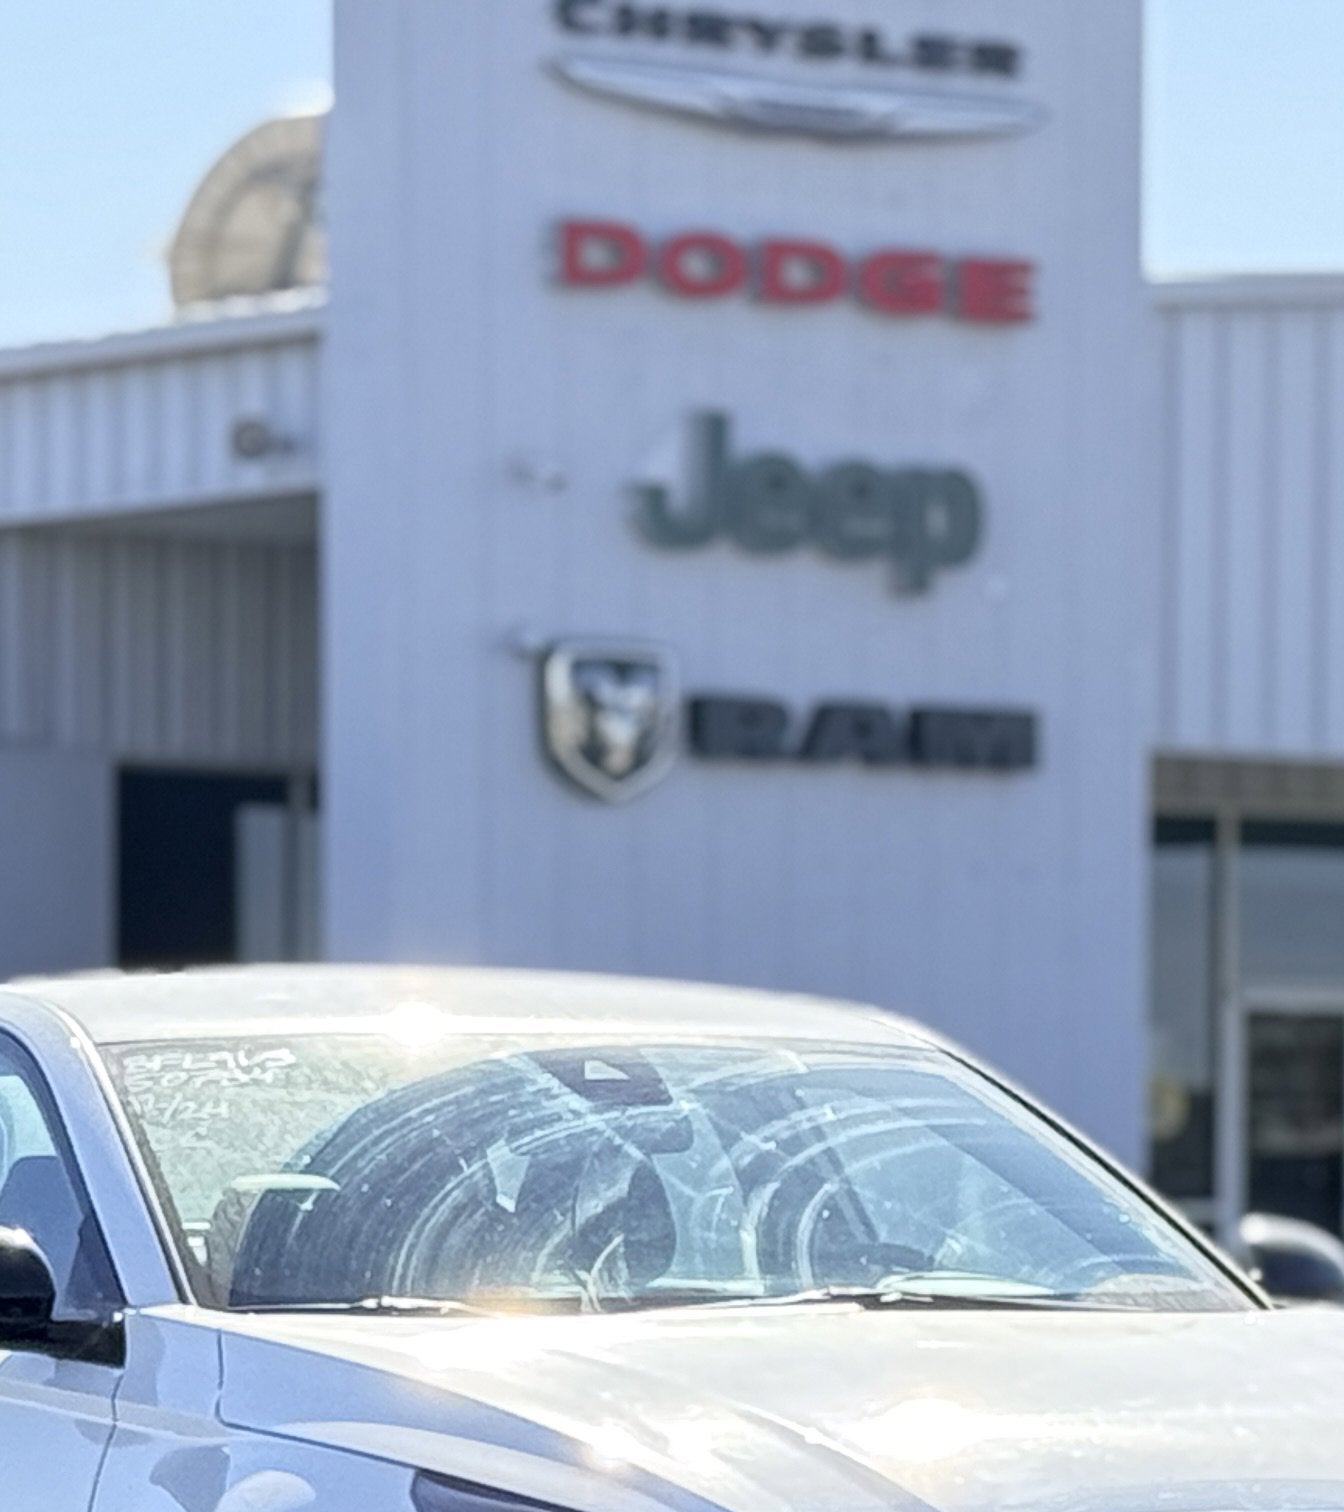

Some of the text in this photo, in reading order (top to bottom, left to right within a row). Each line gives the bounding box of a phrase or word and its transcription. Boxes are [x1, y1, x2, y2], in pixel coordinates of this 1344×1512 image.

[552, 0, 1022, 78] CHRYSLER
[556, 217, 1035, 325] DODGE
[628, 408, 984, 598] Jeep
[686, 695, 1037, 772] RAM
